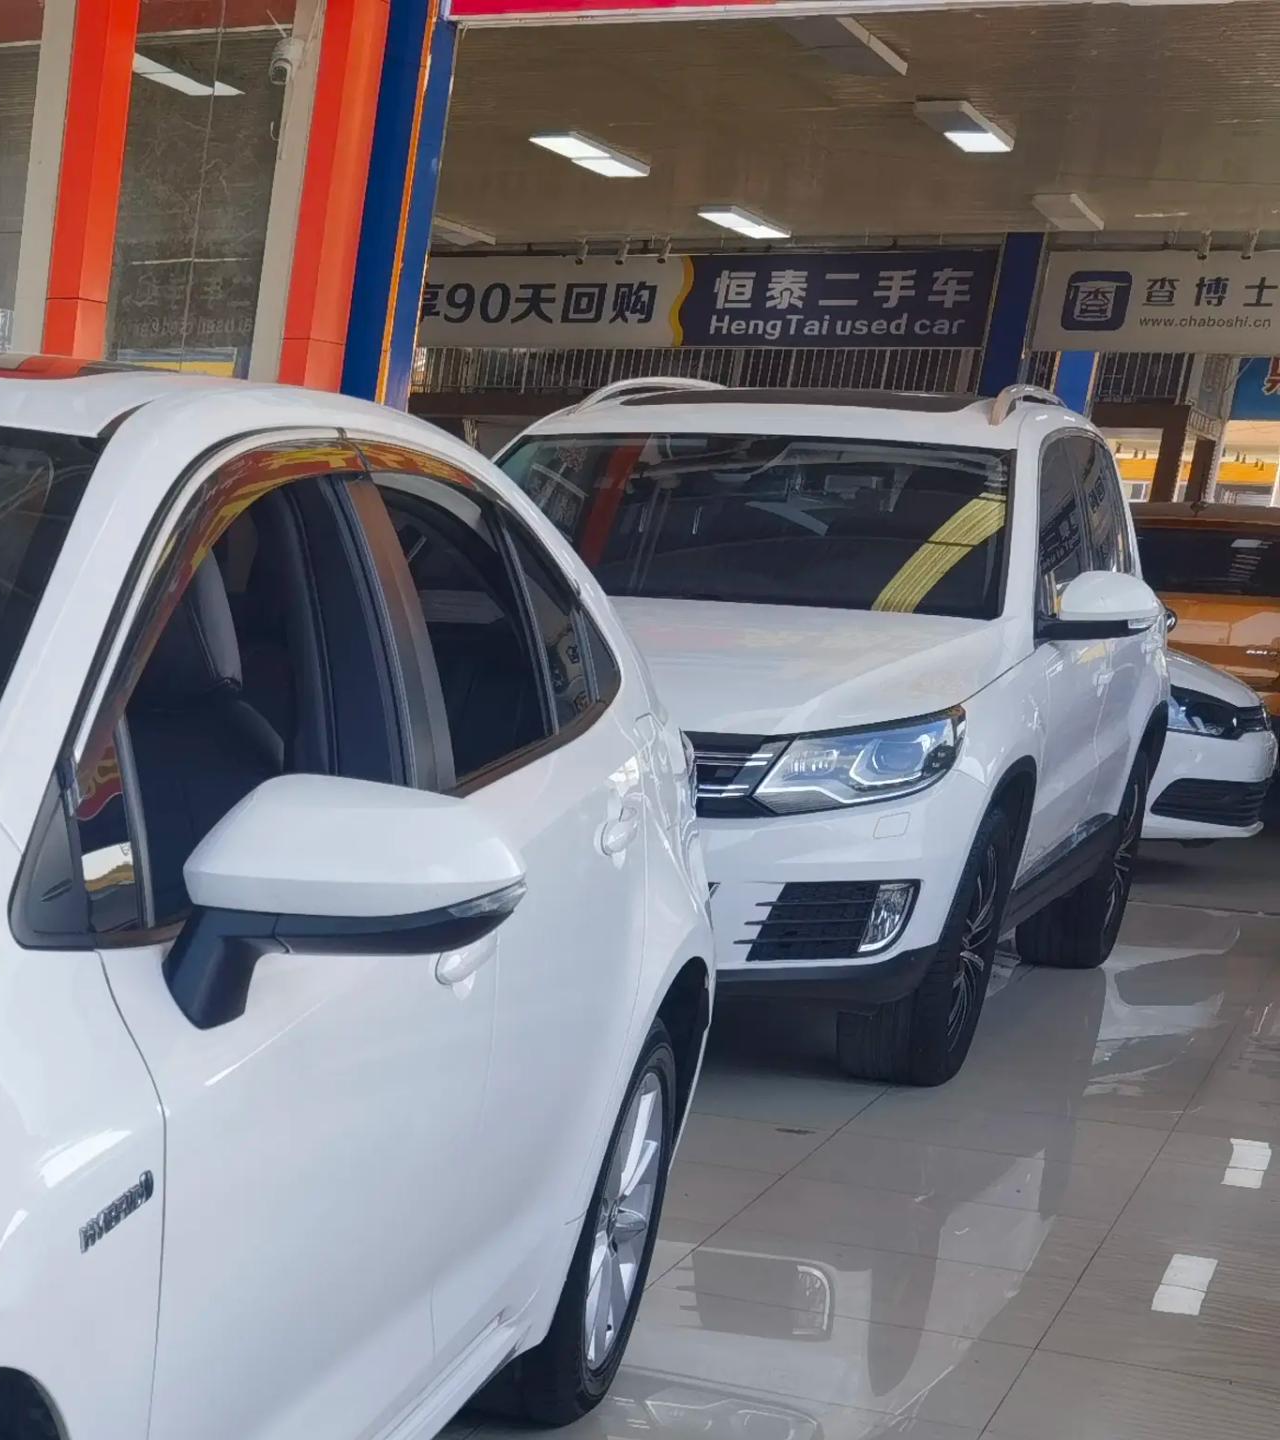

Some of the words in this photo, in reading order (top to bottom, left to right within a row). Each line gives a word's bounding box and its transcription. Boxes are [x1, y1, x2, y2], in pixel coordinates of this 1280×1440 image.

[712, 268, 974, 310] 恒泰二手车
[1142, 276, 1279, 308] 查博士
[836, 313, 908, 336] used
[913, 318, 967, 336] car
[1140, 315, 1272, 330] www.chaboshi.cn
